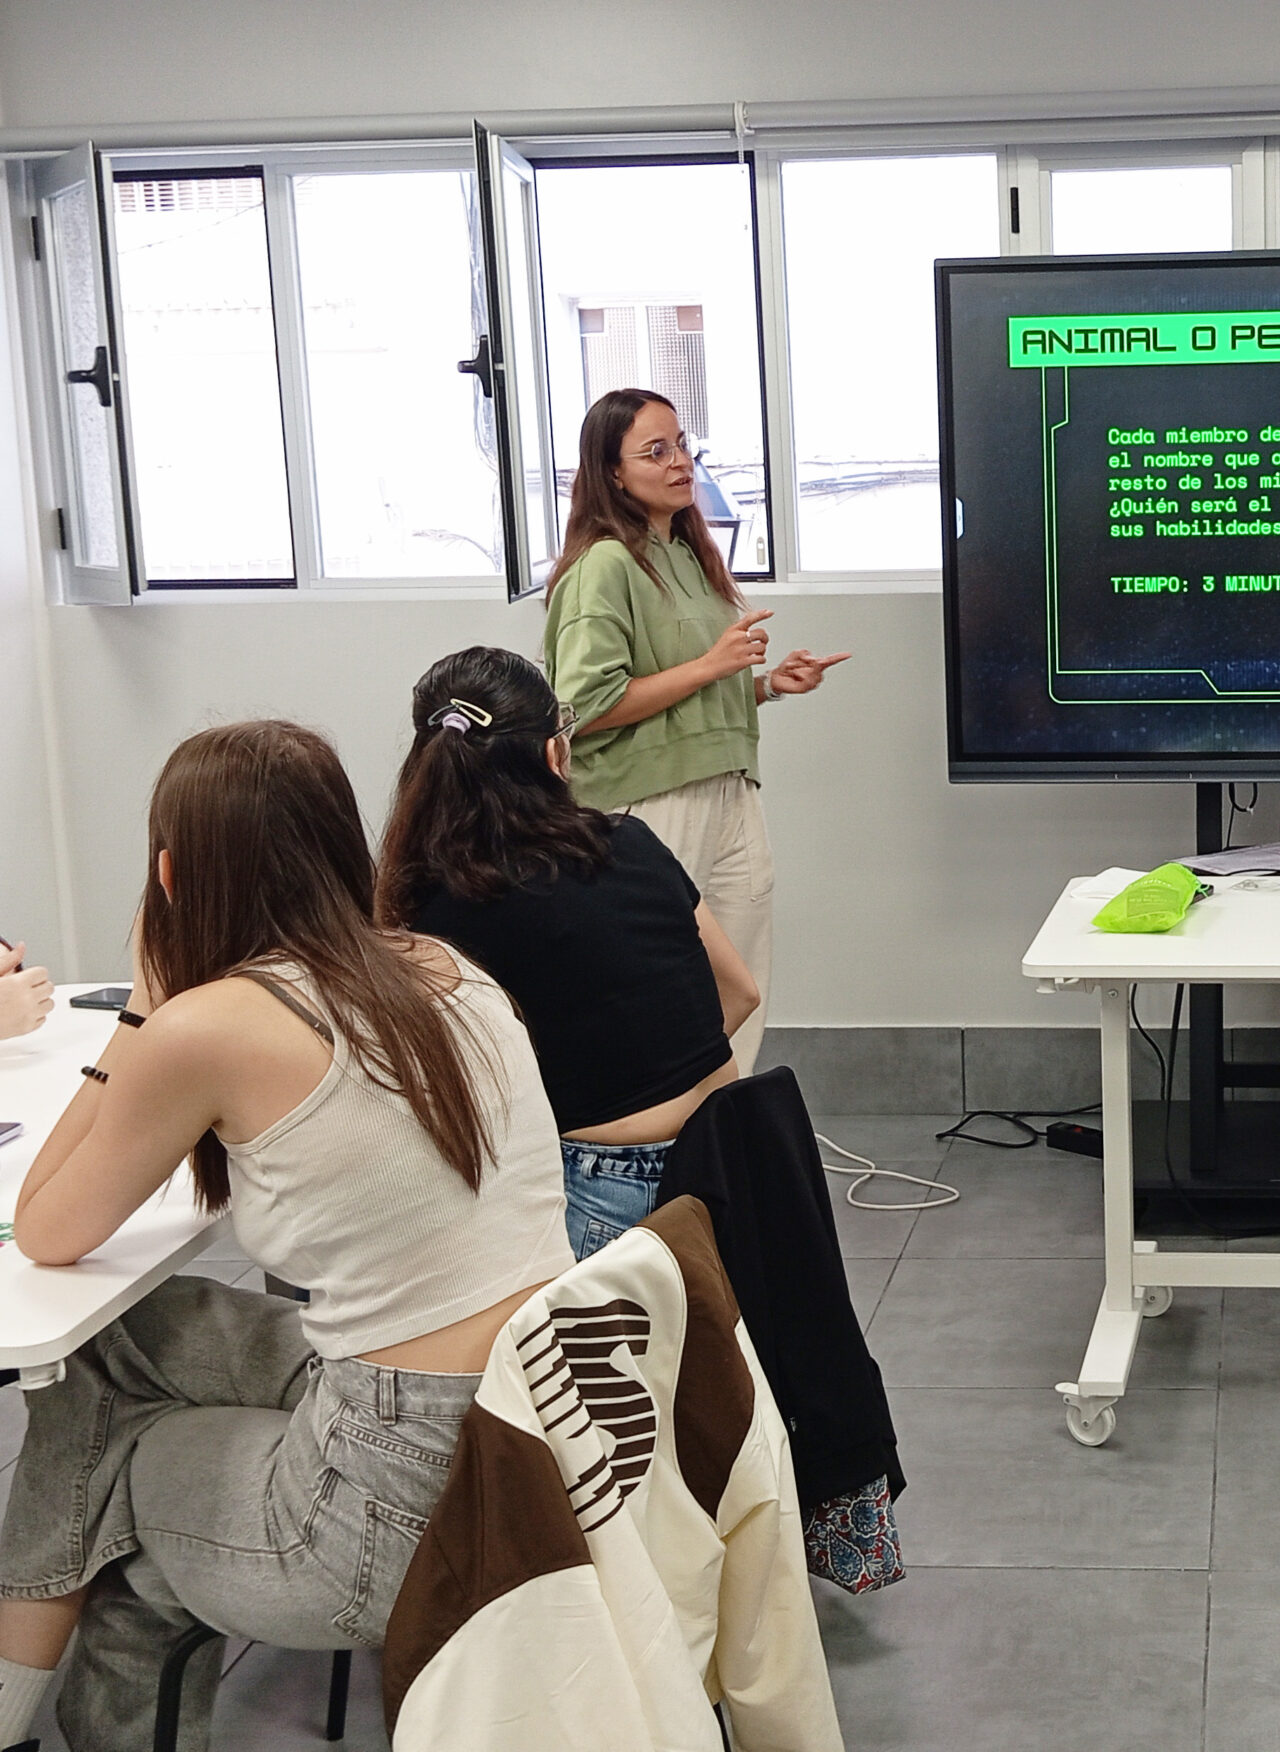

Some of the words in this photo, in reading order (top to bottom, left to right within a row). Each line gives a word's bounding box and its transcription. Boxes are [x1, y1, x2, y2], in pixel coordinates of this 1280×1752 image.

[1022, 327, 1177, 355] ANIMAL
[1191, 325, 1217, 351] O
[1107, 427, 1156, 446] Cada
[1165, 426, 1249, 445] miembro
[1108, 451, 1132, 470] el
[1143, 450, 1214, 469] nombre
[1224, 452, 1261, 469] que
[1108, 474, 1168, 492] resto
[1177, 473, 1202, 491] de
[1214, 472, 1248, 489] los
[1109, 496, 1179, 518] ¿Quién
[1190, 495, 1238, 514] será
[1248, 495, 1272, 513] el
[1111, 522, 1144, 537] sus
[1110, 575, 1189, 594] TIEMPO:
[1202, 575, 1215, 593] 3
